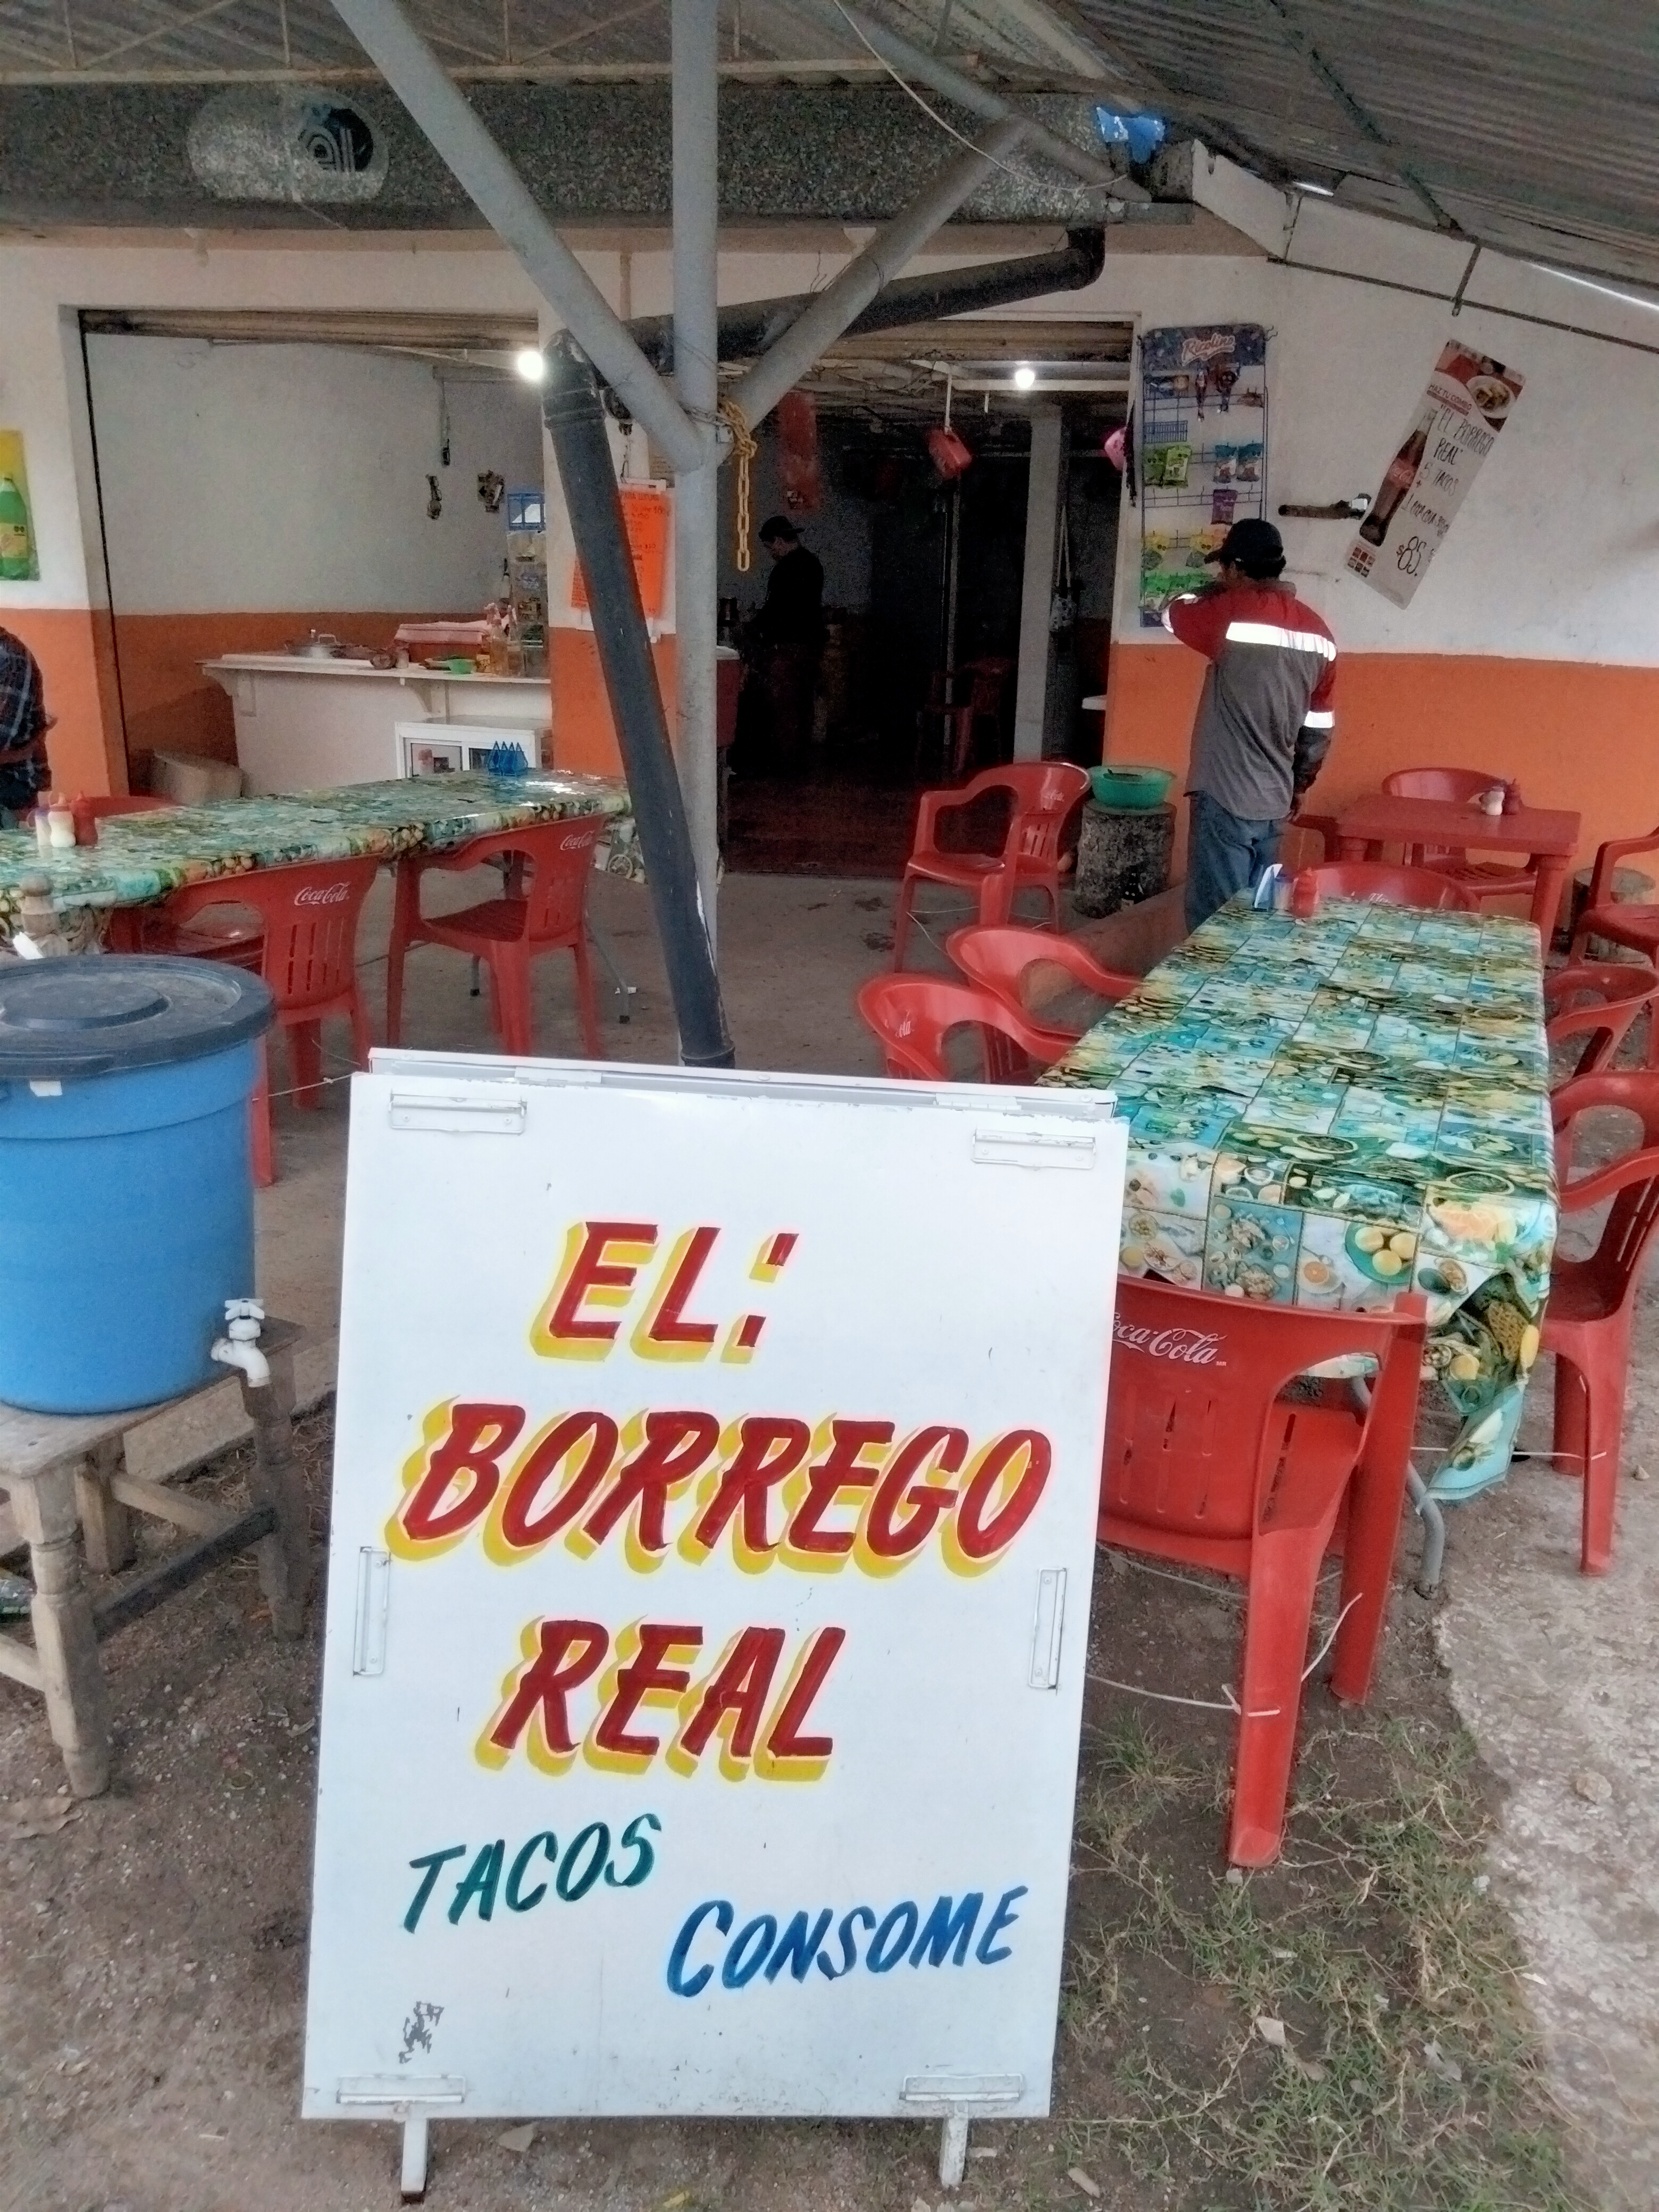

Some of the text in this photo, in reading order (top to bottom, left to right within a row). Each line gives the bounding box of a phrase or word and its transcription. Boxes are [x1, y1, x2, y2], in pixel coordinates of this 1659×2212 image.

[1432, 469, 1459, 496] TACOS
[294, 882, 351, 906] Coca-Cola
[1112, 1312, 1228, 1364] oca-Cola
[384, 1396, 1052, 1579] BORREGO
[474, 1614, 846, 1781] REAL
[404, 1813, 661, 1933] TACOS
[666, 1886, 1028, 1998] CONSOME
